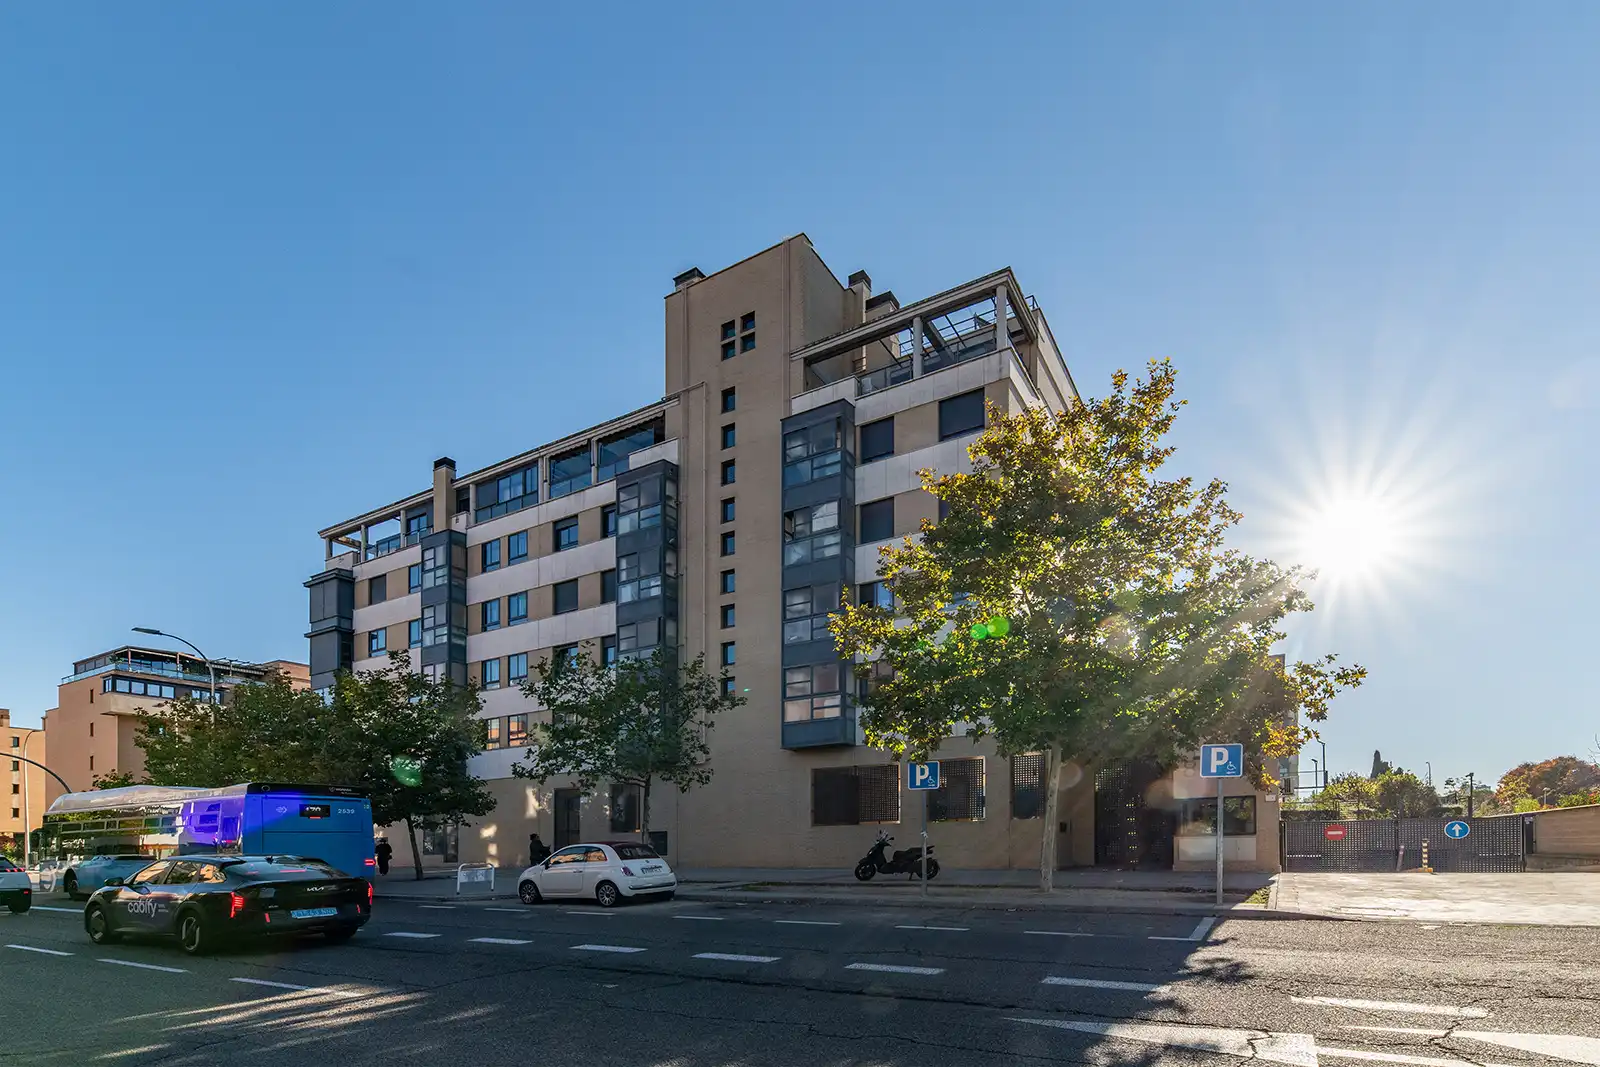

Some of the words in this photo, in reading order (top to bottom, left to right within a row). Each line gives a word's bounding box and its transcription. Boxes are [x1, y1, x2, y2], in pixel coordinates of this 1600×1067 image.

[1210, 747, 1229, 773] P
[916, 763, 929, 786] P
[127, 898, 157, 918] cabify
